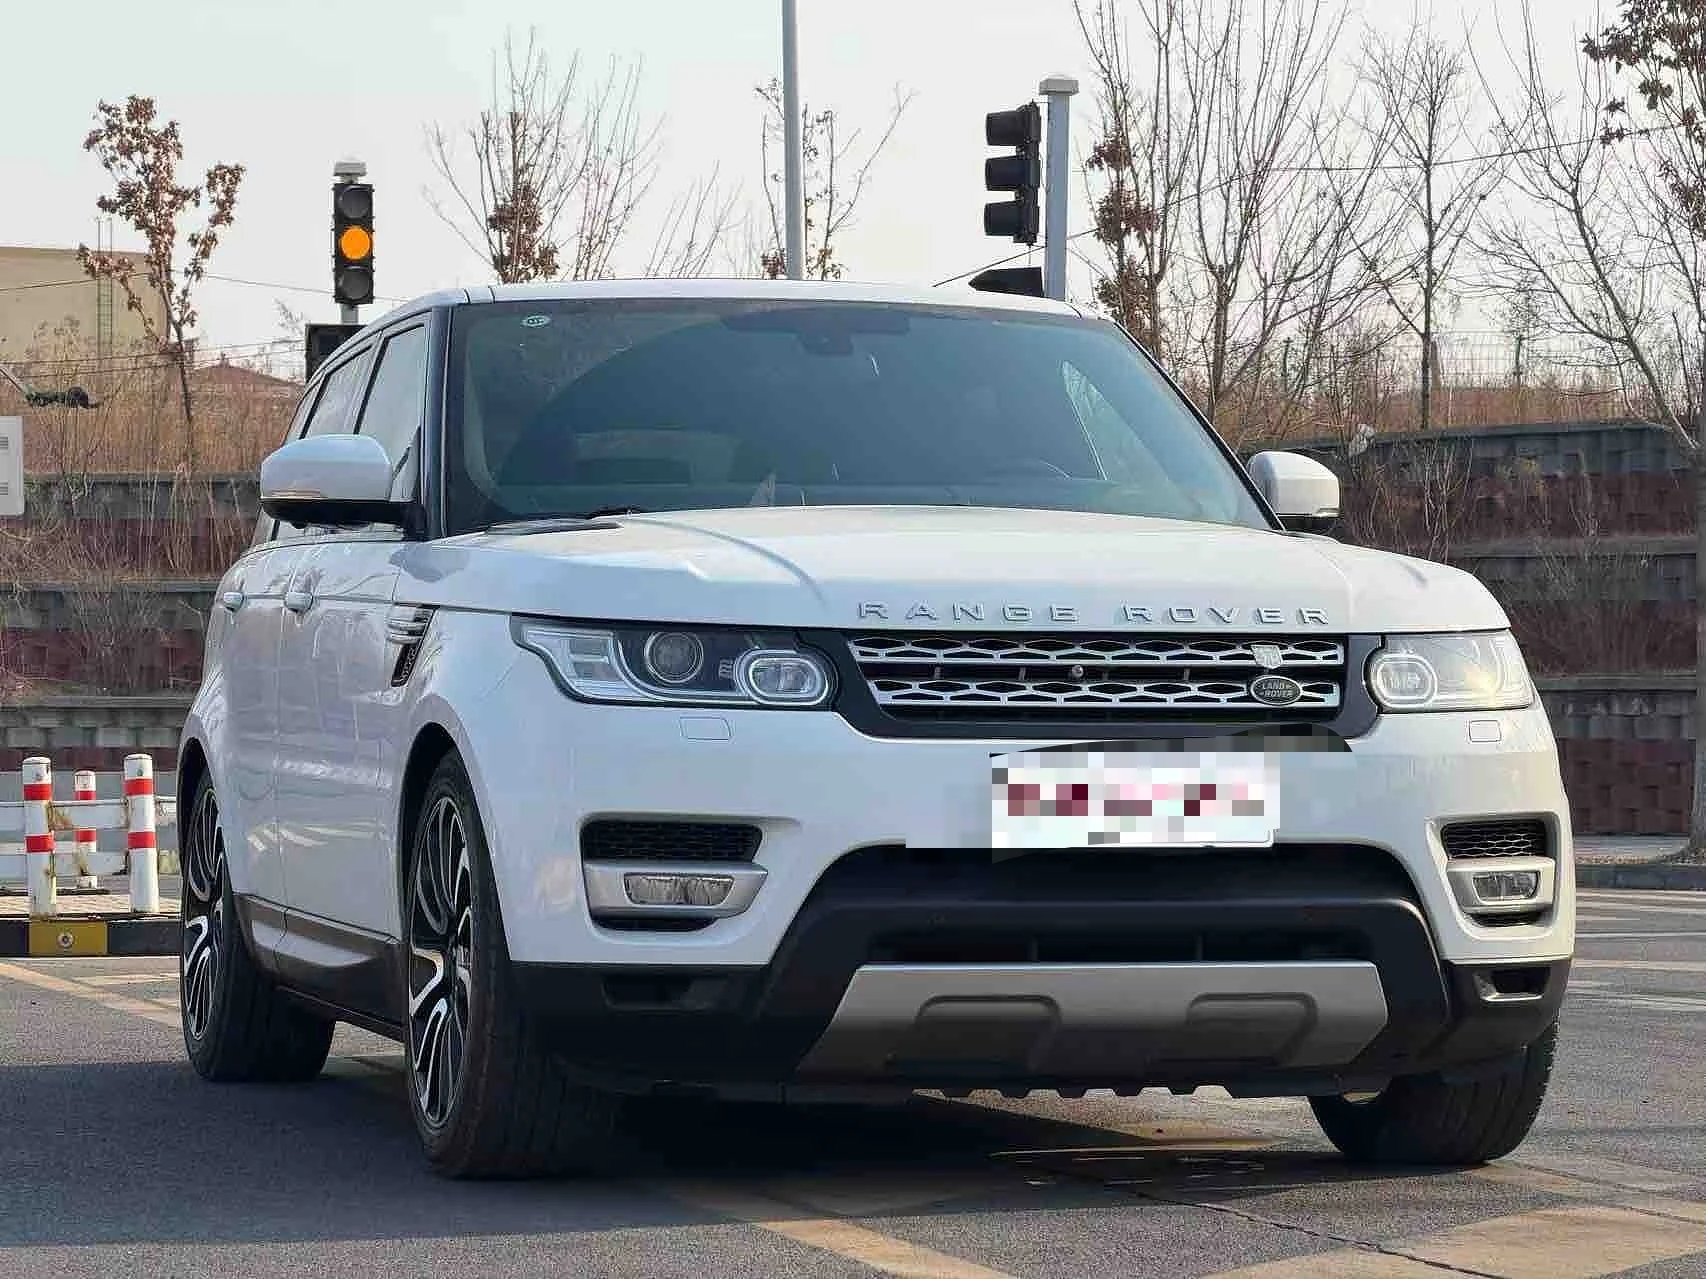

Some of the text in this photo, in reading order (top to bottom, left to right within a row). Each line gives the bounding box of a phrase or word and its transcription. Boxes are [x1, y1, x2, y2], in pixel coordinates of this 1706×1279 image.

[858, 600, 1329, 625] RANGE ROVER
[1261, 681, 1287, 690] LAND
